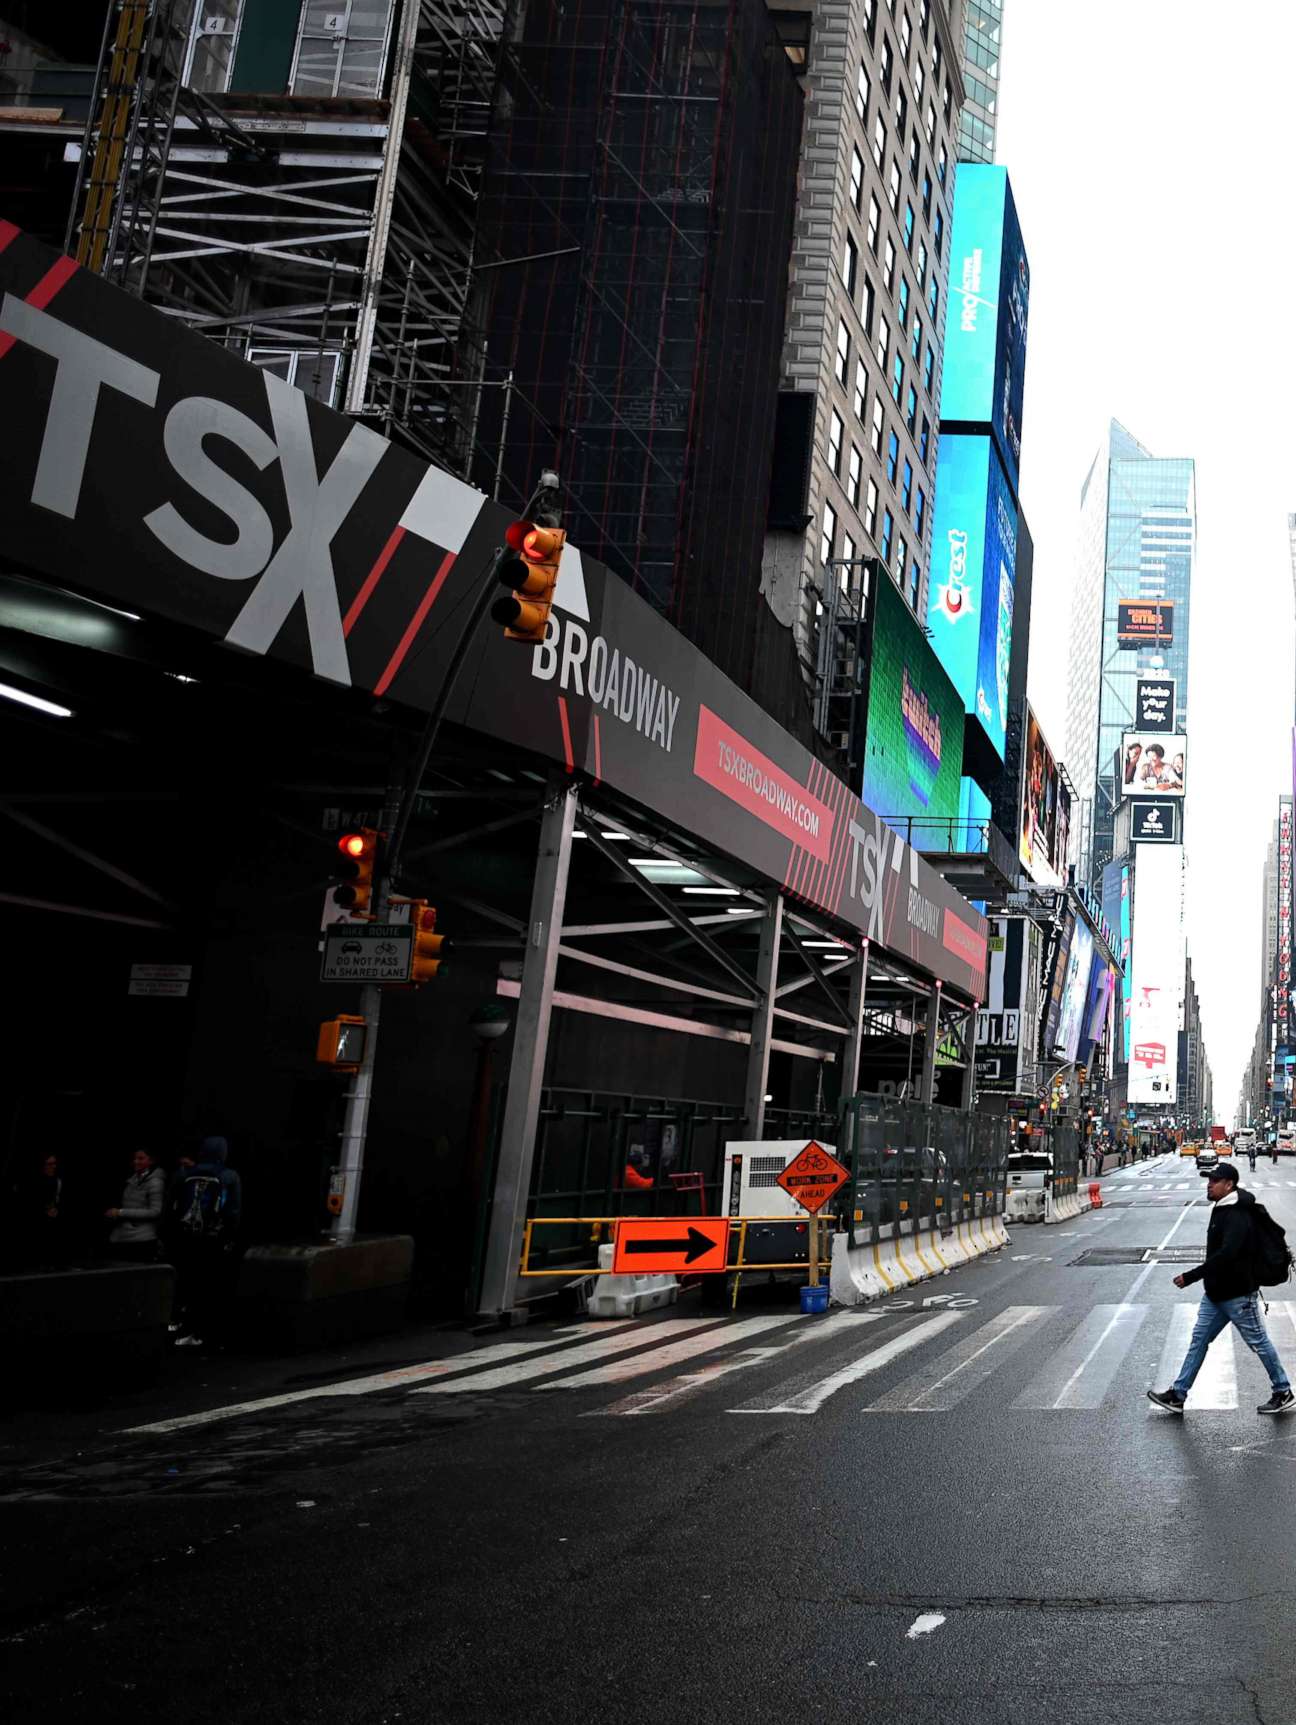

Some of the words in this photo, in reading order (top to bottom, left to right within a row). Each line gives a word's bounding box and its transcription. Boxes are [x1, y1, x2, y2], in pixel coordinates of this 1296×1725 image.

[0, 290, 392, 686] TSX
[945, 528, 968, 614] Crest
[531, 608, 681, 753] BROADWAY
[1140, 686, 1170, 697] Make
[1143, 698, 1168, 710] your
[1143, 710, 1167, 723] day.
[718, 740, 819, 838] TSXBROADWAY.COM
[849, 816, 891, 946] TSX
[907, 887, 940, 939] BROADWAY
[368, 926, 400, 936] ROUTE
[336, 957, 349, 966] DO
[353, 957, 372, 966] NOT
[374, 957, 398, 966] PASS
[326, 967, 336, 977] IN
[339, 967, 378, 977] SHARED
[382, 967, 405, 977] LANE
[800, 1189, 825, 1199] AHEAD
